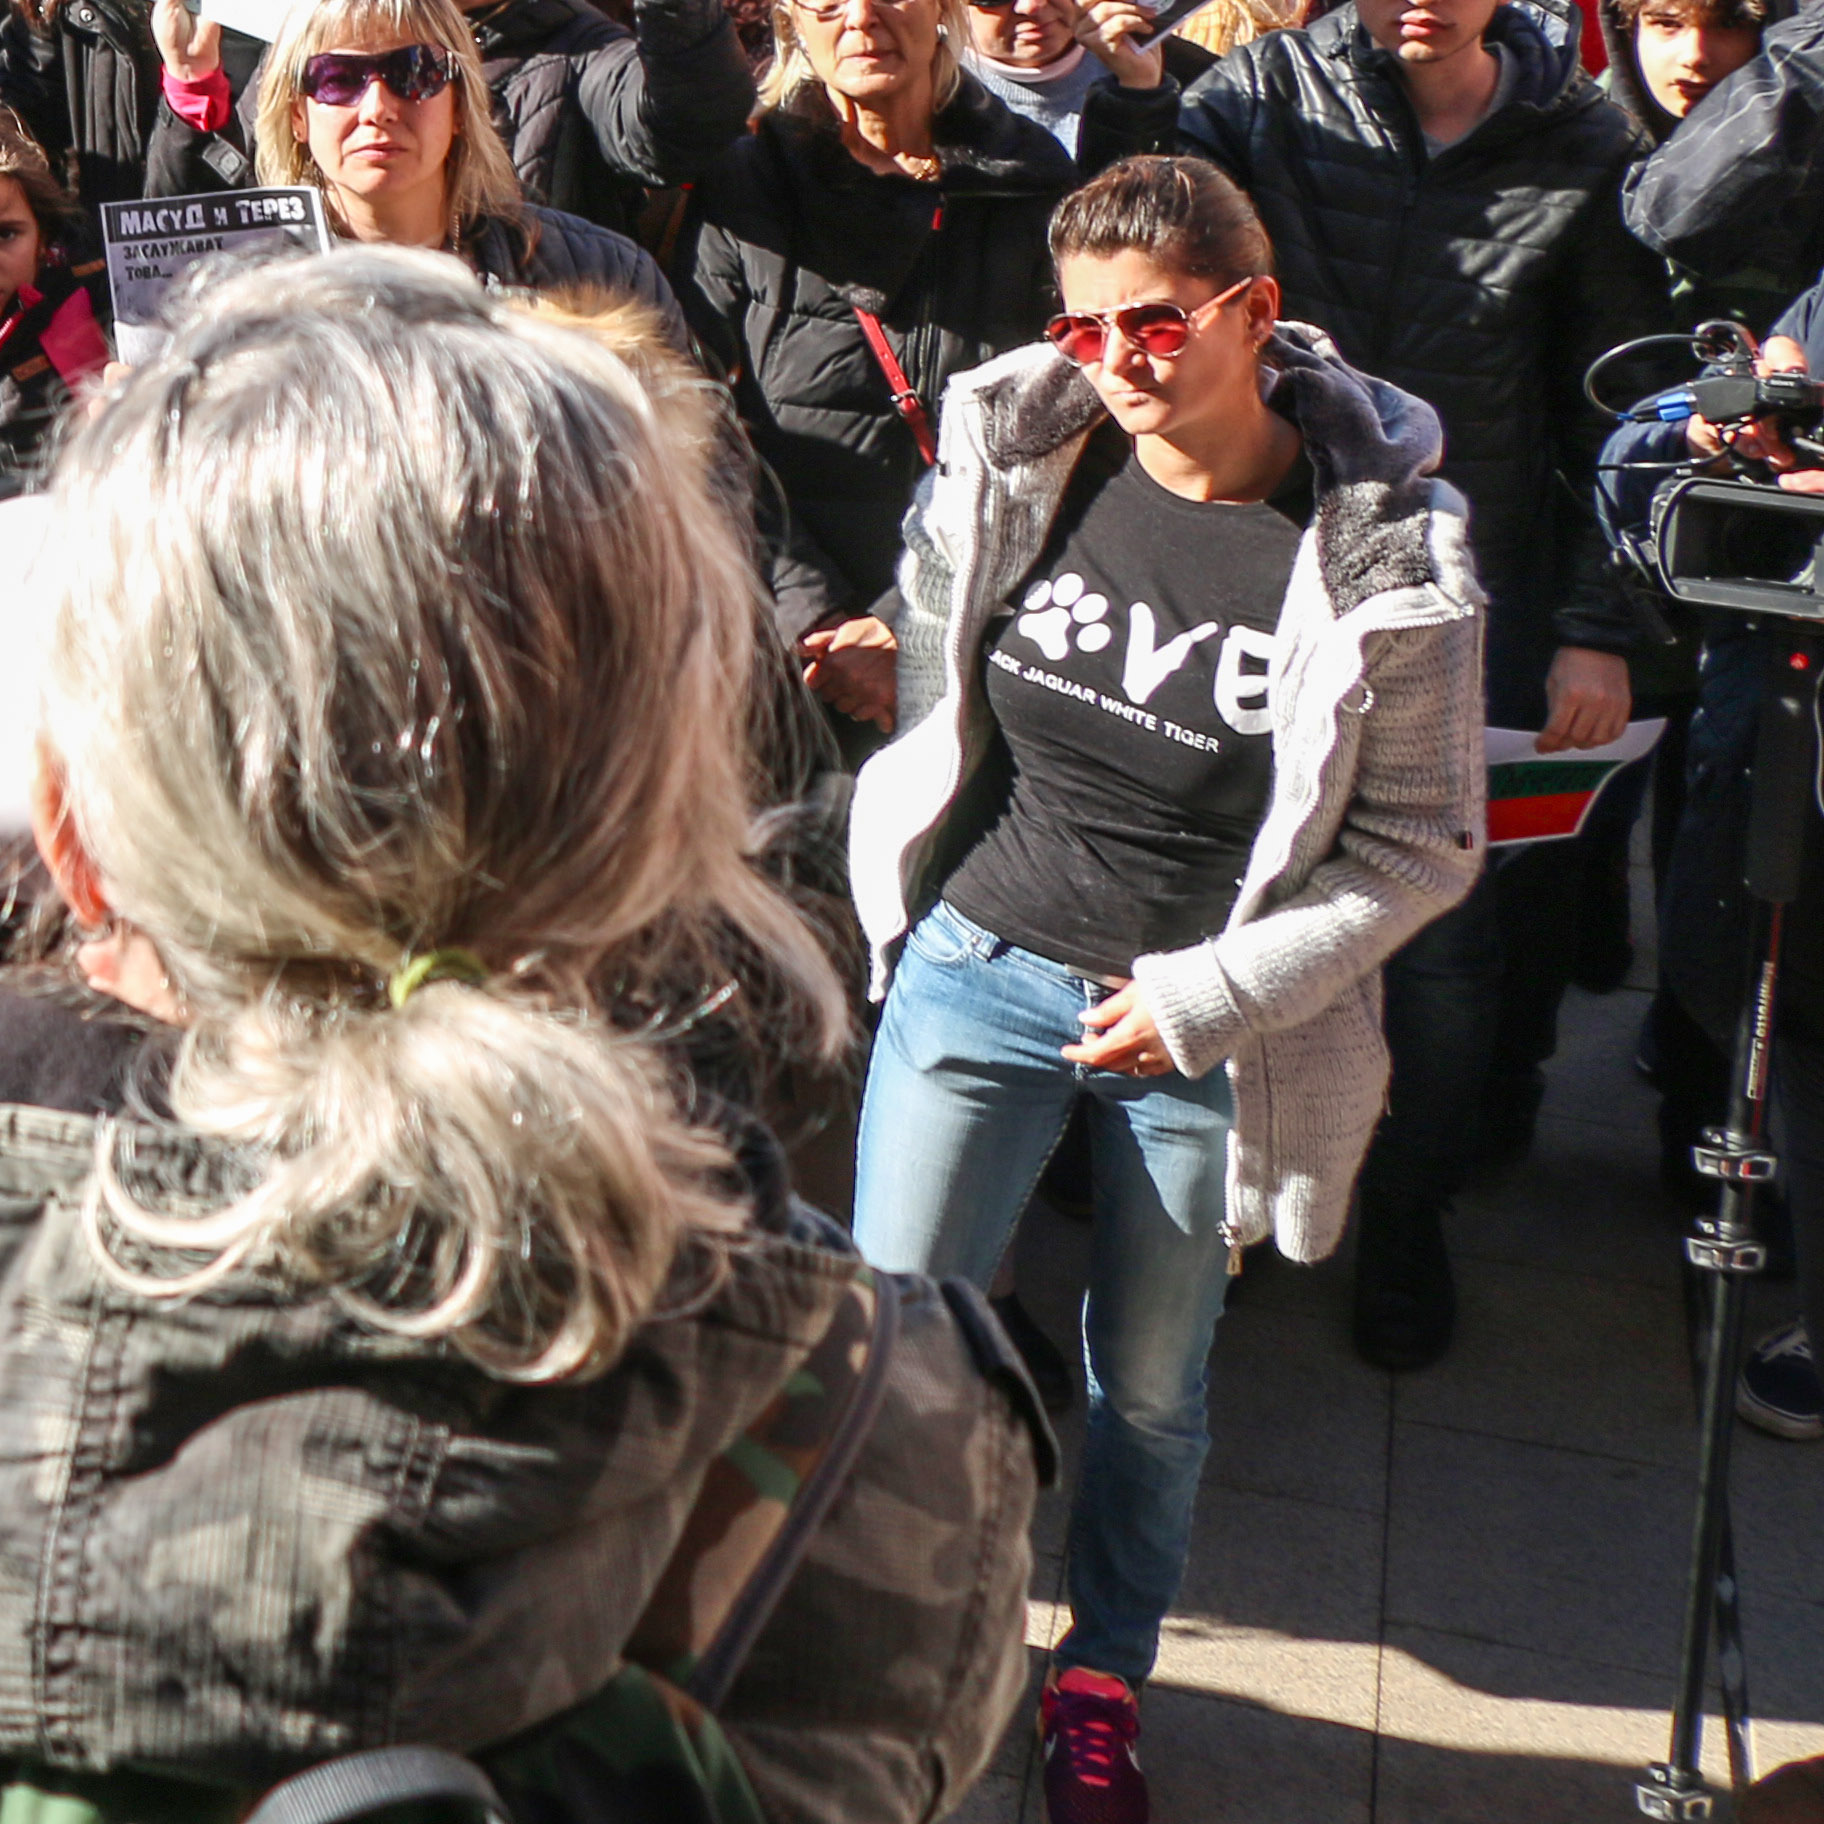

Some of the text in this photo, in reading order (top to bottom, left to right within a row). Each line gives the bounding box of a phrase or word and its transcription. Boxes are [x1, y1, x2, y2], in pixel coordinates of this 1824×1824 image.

[120, 197, 305, 235] МАСУД ТЕРЕЗ
[123, 237, 223, 260] ЗАСЛУЖАВАТ
[1024, 666, 1220, 755] JAGUAR WHITE TIGER
